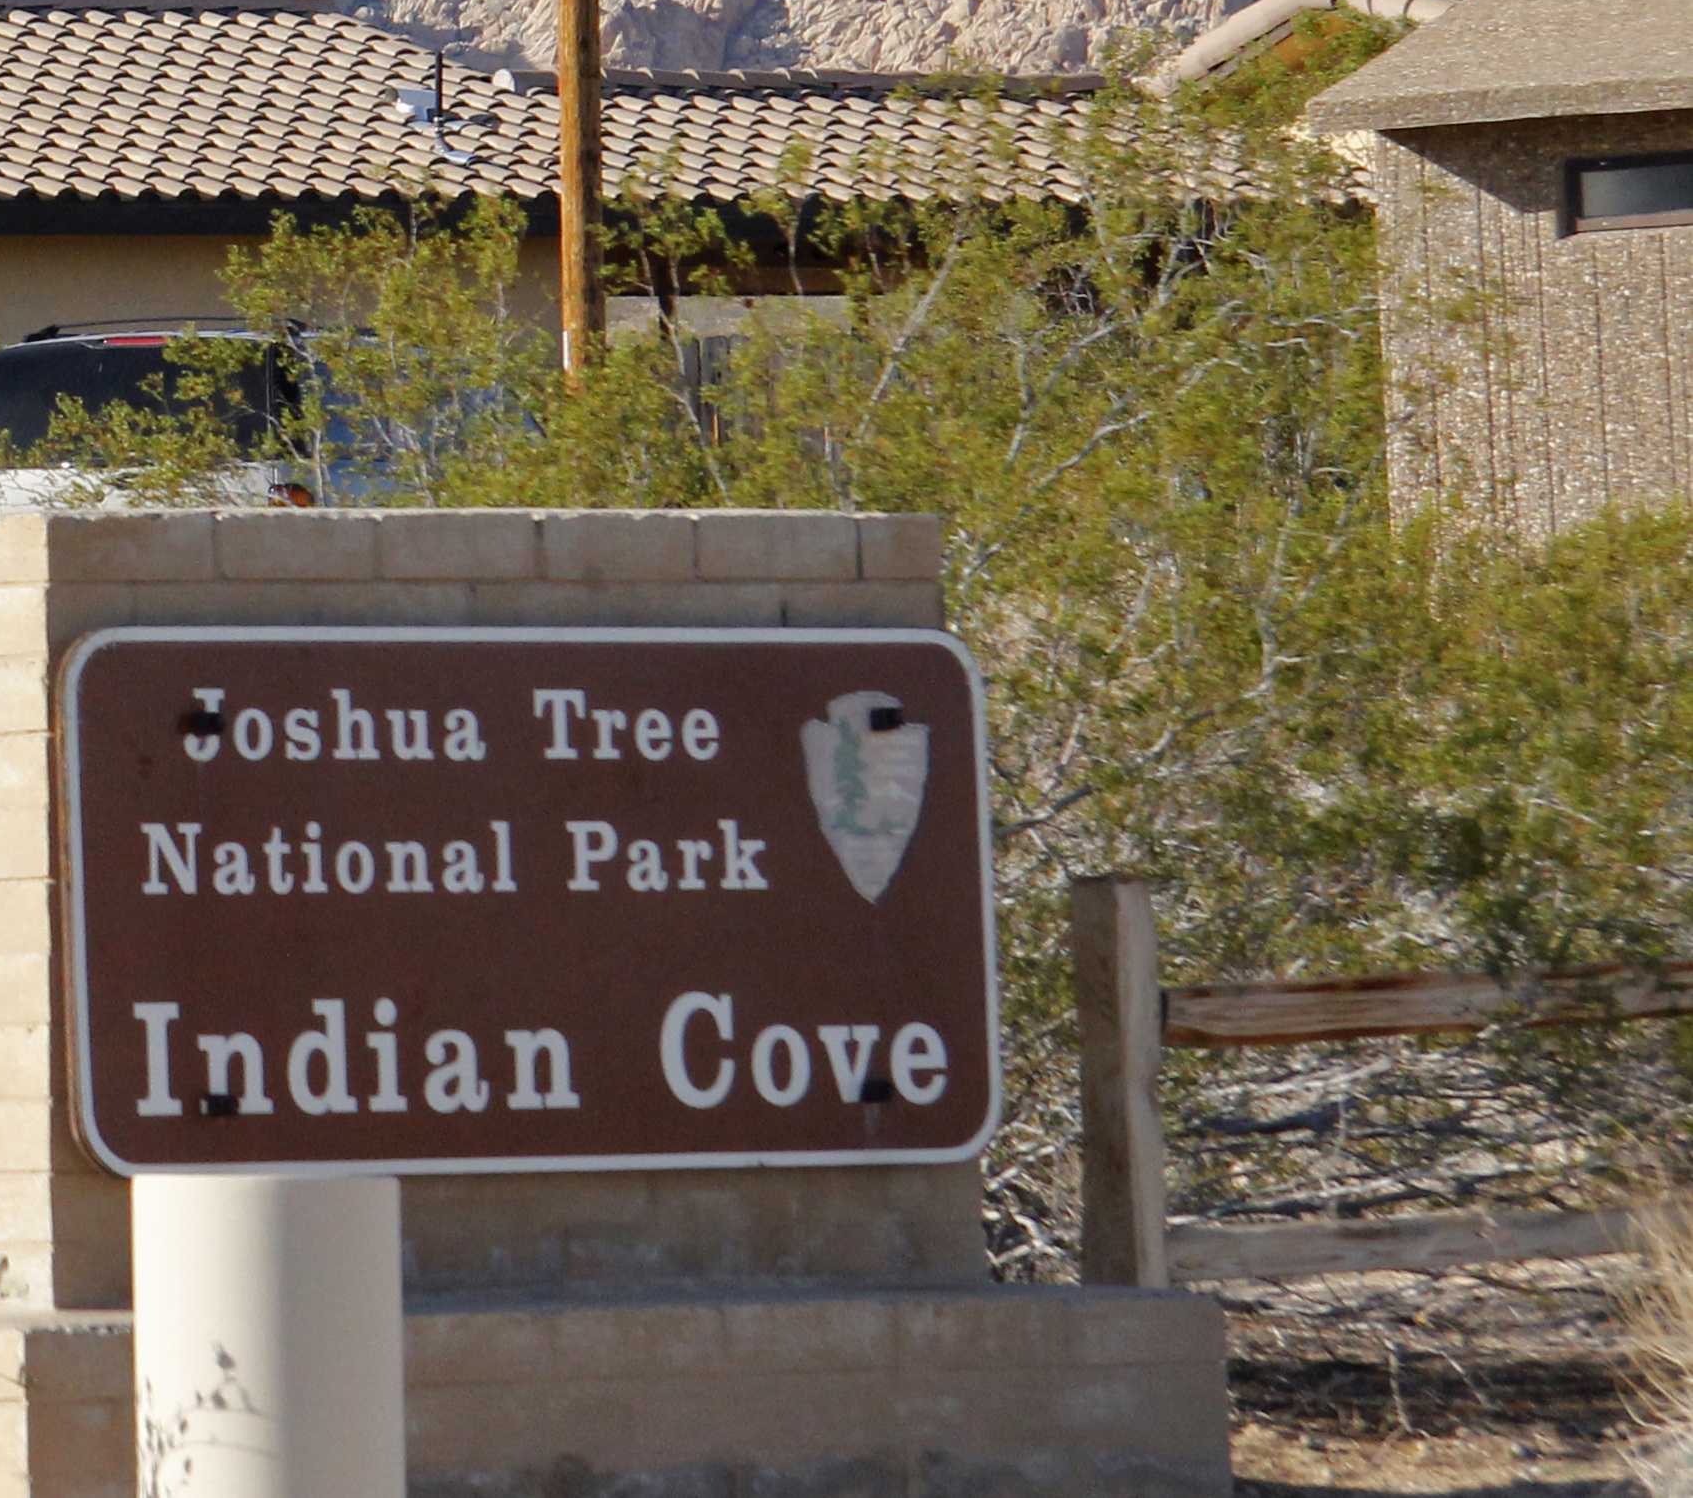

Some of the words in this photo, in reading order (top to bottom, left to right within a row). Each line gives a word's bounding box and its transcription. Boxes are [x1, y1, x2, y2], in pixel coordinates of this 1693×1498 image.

[182, 688, 487, 763] Joshua
[532, 688, 721, 762] Tree
[140, 820, 518, 896] National
[564, 819, 770, 893] Park
[132, 997, 581, 1118] Indian
[659, 991, 949, 1110] Cove
